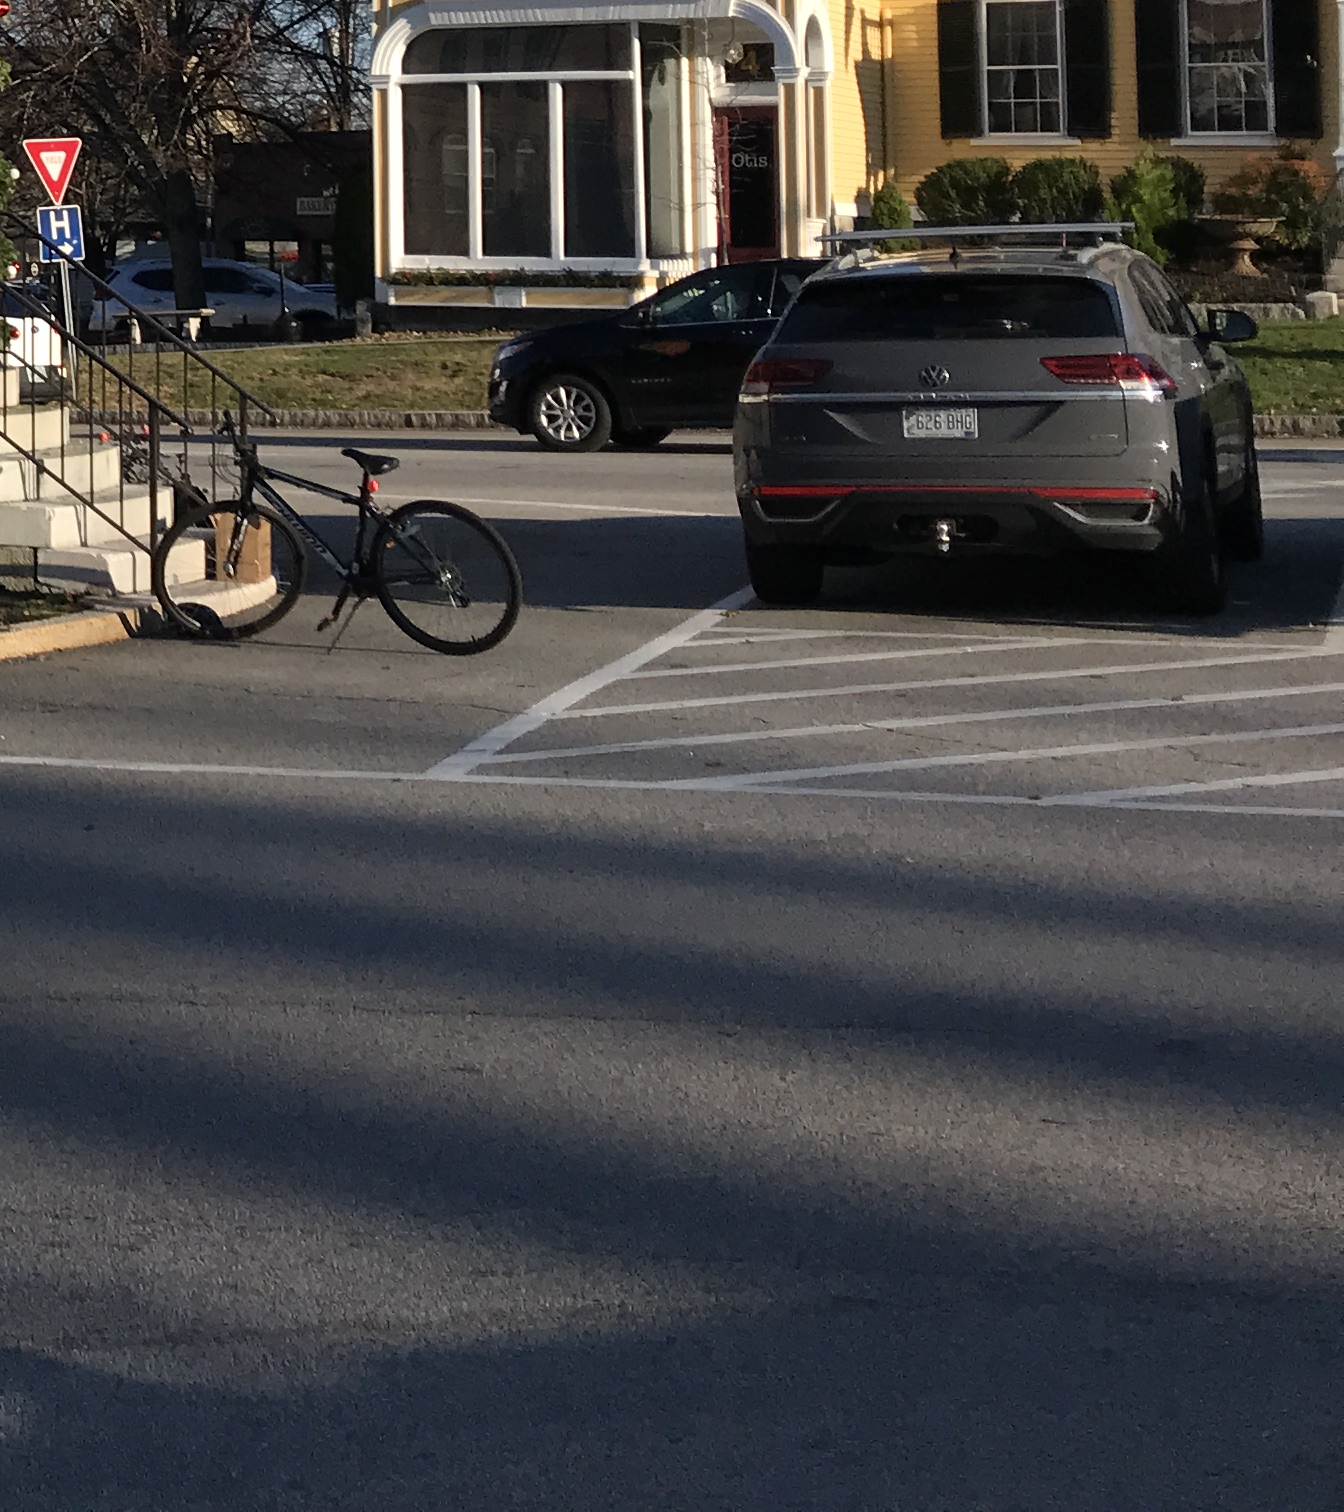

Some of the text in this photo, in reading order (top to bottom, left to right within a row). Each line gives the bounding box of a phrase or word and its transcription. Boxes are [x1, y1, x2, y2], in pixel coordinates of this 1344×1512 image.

[741, 48, 760, 79] 4
[45, 155, 62, 165] YIELD
[731, 152, 768, 168] Otis
[49, 209, 71, 240] H
